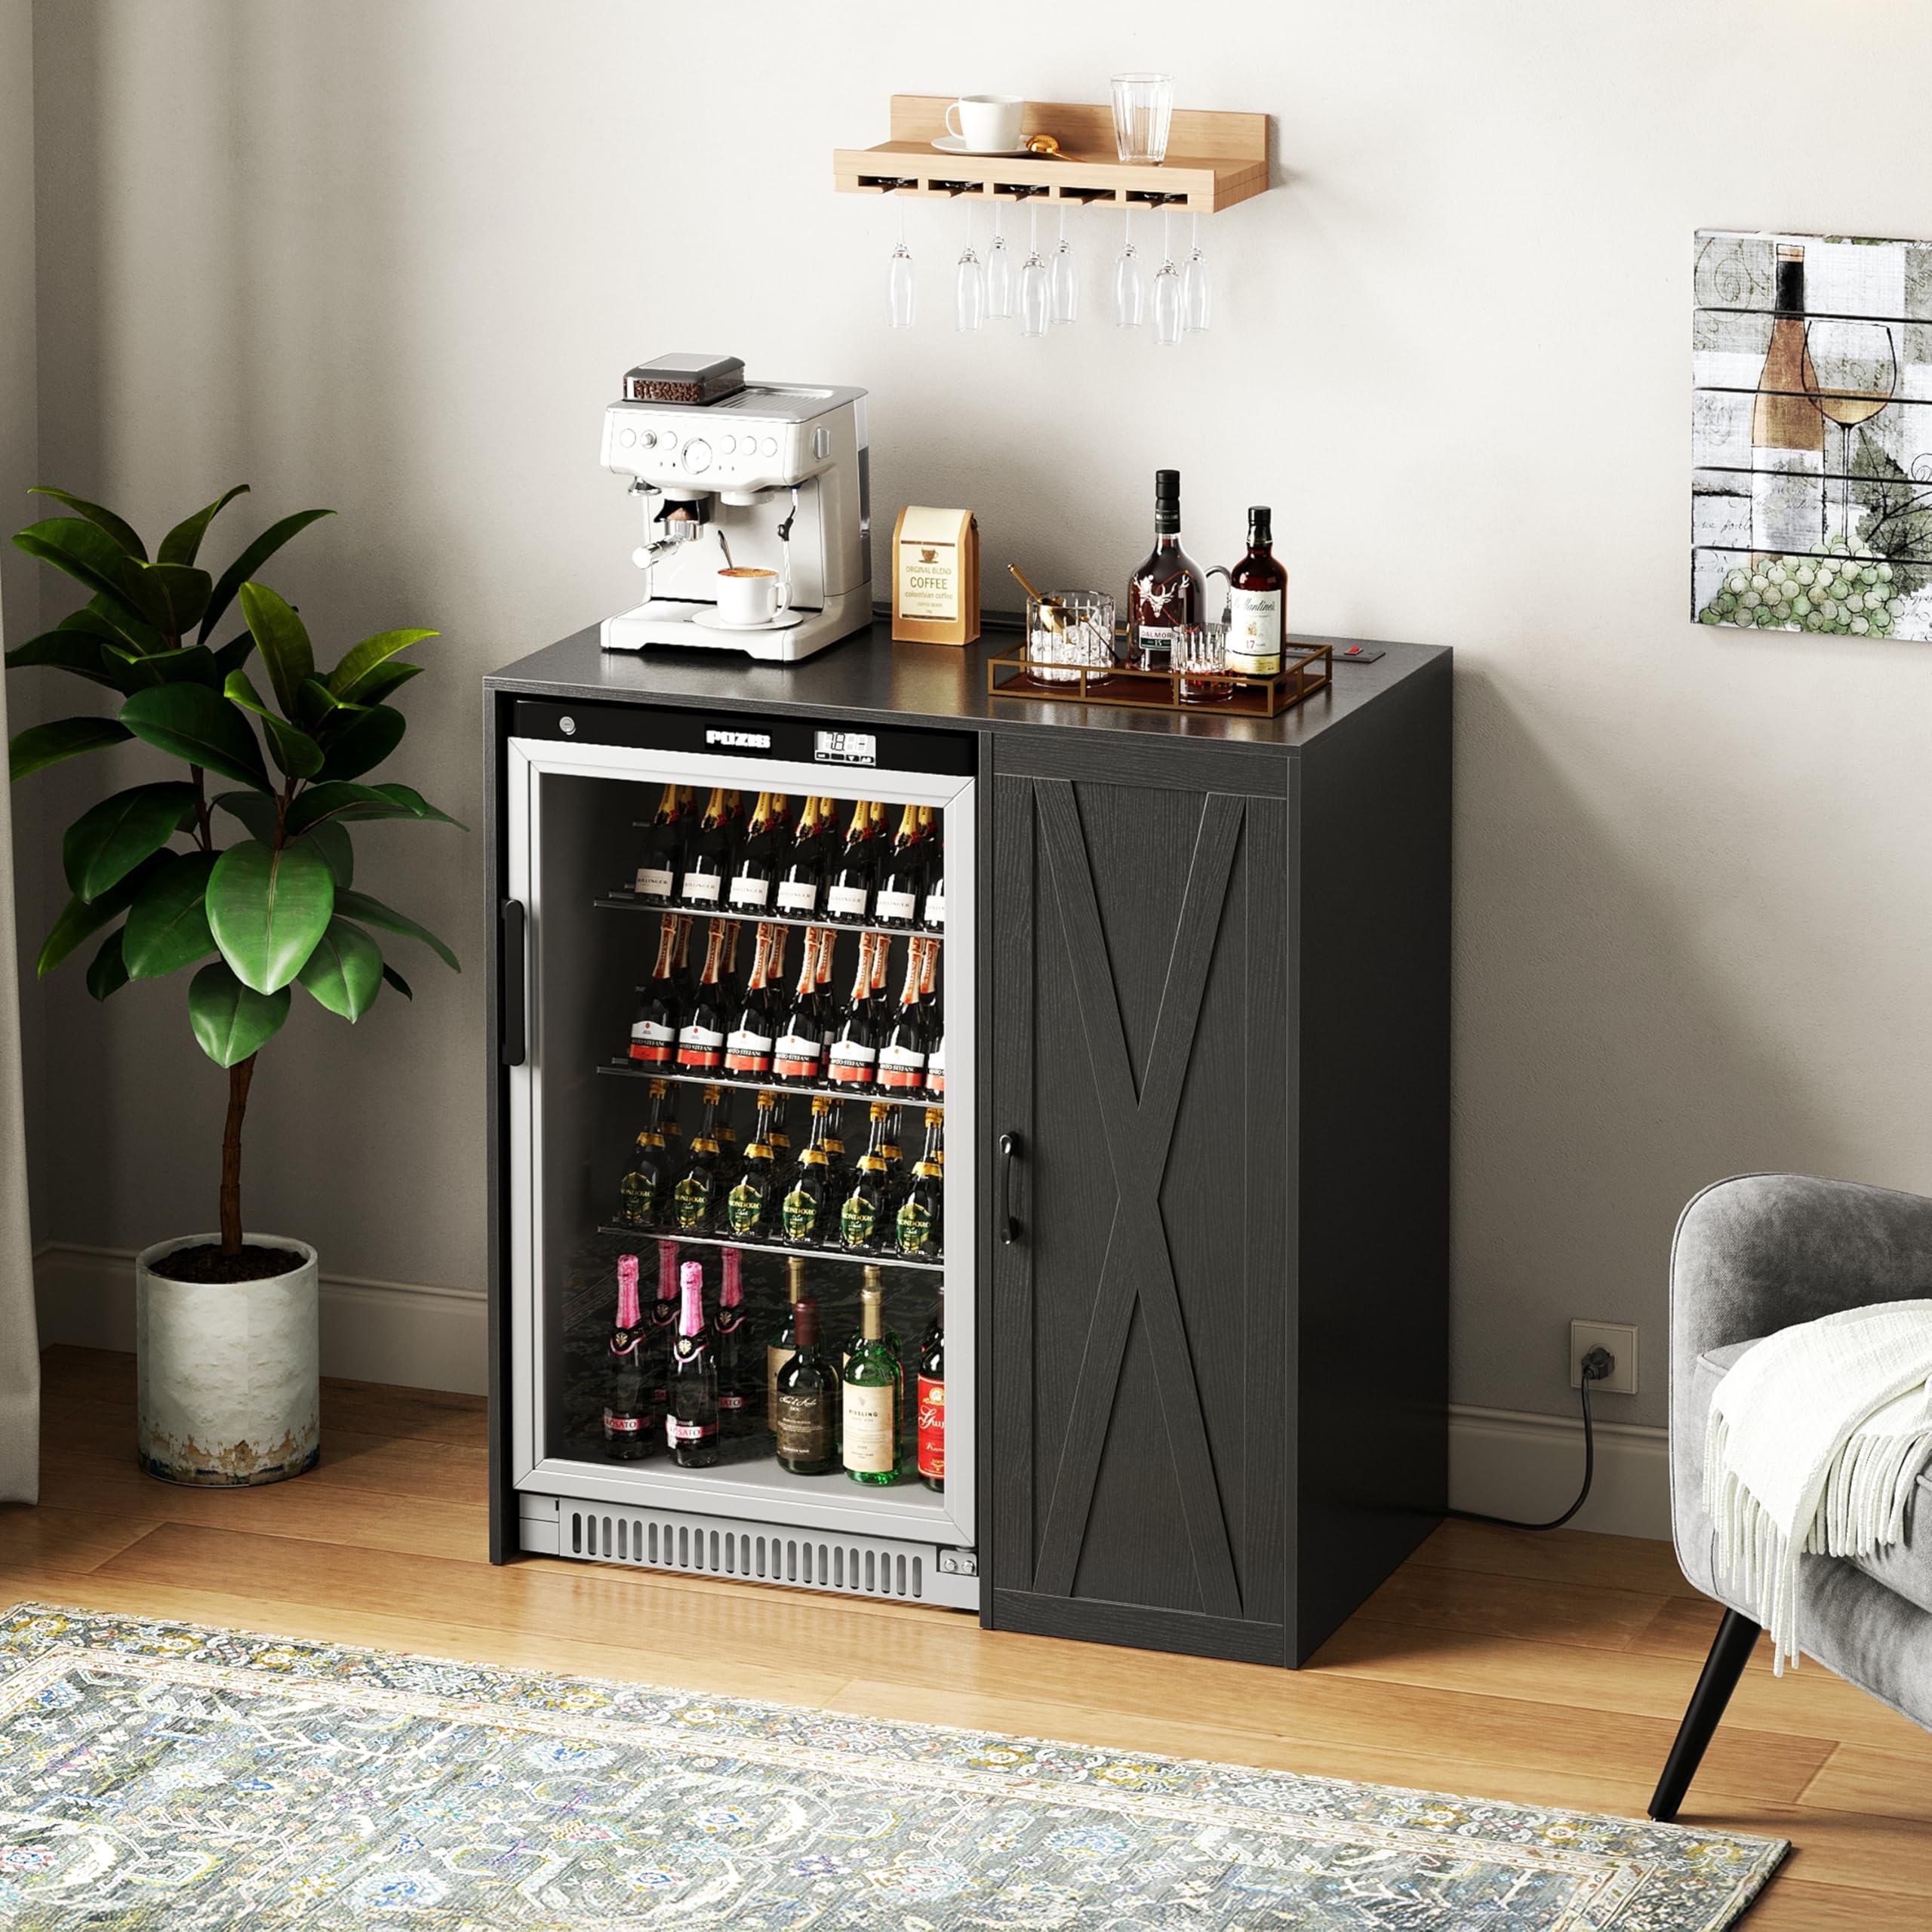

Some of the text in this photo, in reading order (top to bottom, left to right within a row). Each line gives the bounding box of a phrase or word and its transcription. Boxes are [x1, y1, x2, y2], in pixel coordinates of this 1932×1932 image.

[910, 577, 948, 589] COFFEE
[1141, 630, 1172, 639] DALMOR
[1245, 640, 1255, 649] 17
